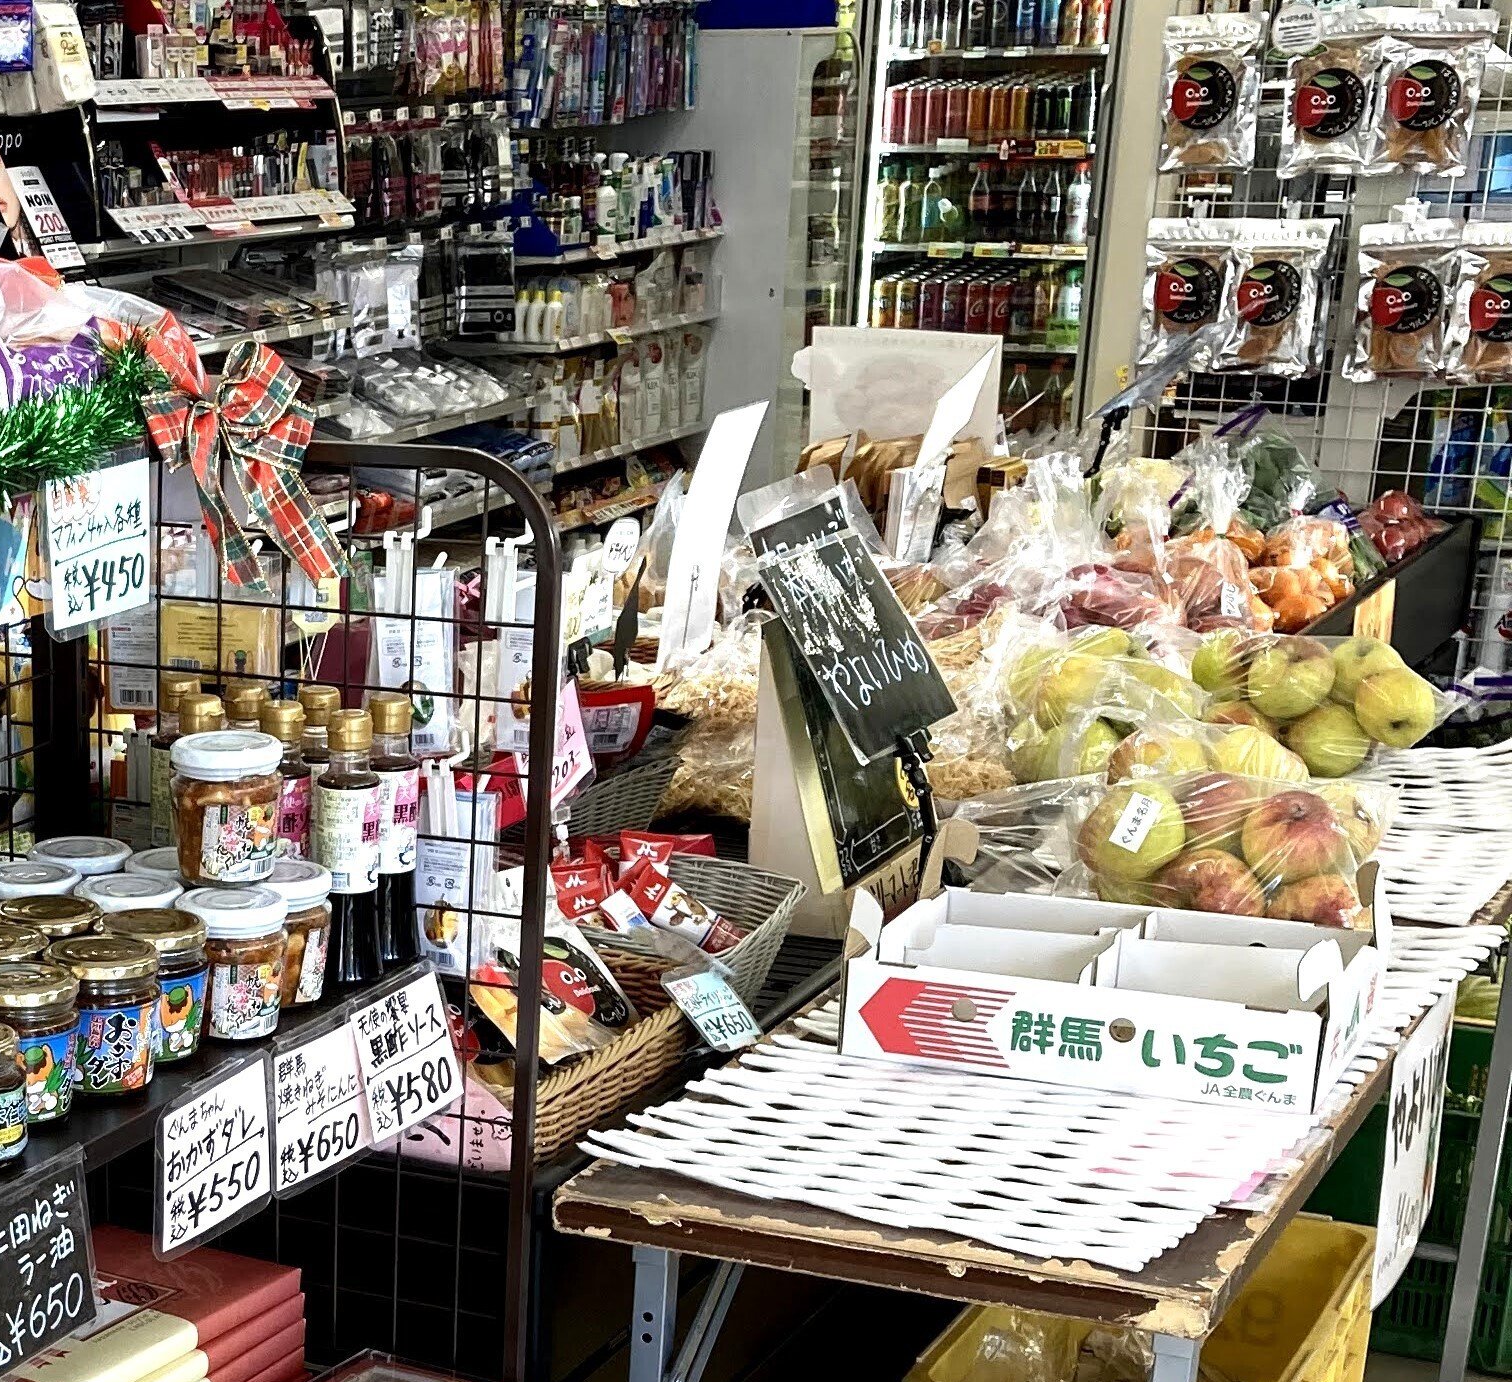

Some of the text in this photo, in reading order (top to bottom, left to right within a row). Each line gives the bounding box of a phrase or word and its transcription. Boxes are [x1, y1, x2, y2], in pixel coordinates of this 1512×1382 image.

[1121, 796, 1154, 845] ぐんま名月
[369, 1003, 442, 1068] 黒酢ソース
[707, 1010, 753, 1040] ¥650
[1009, 1010, 1304, 1084] 群馬 いちご
[277, 1053, 307, 1083] 群馬
[386, 1056, 453, 1127] ¥580
[298, 1112, 361, 1173] ¥650
[187, 1151, 261, 1228] ¥550
[17, 1224, 76, 1286] ラー油
[6, 1272, 84, 1356] ¥650
